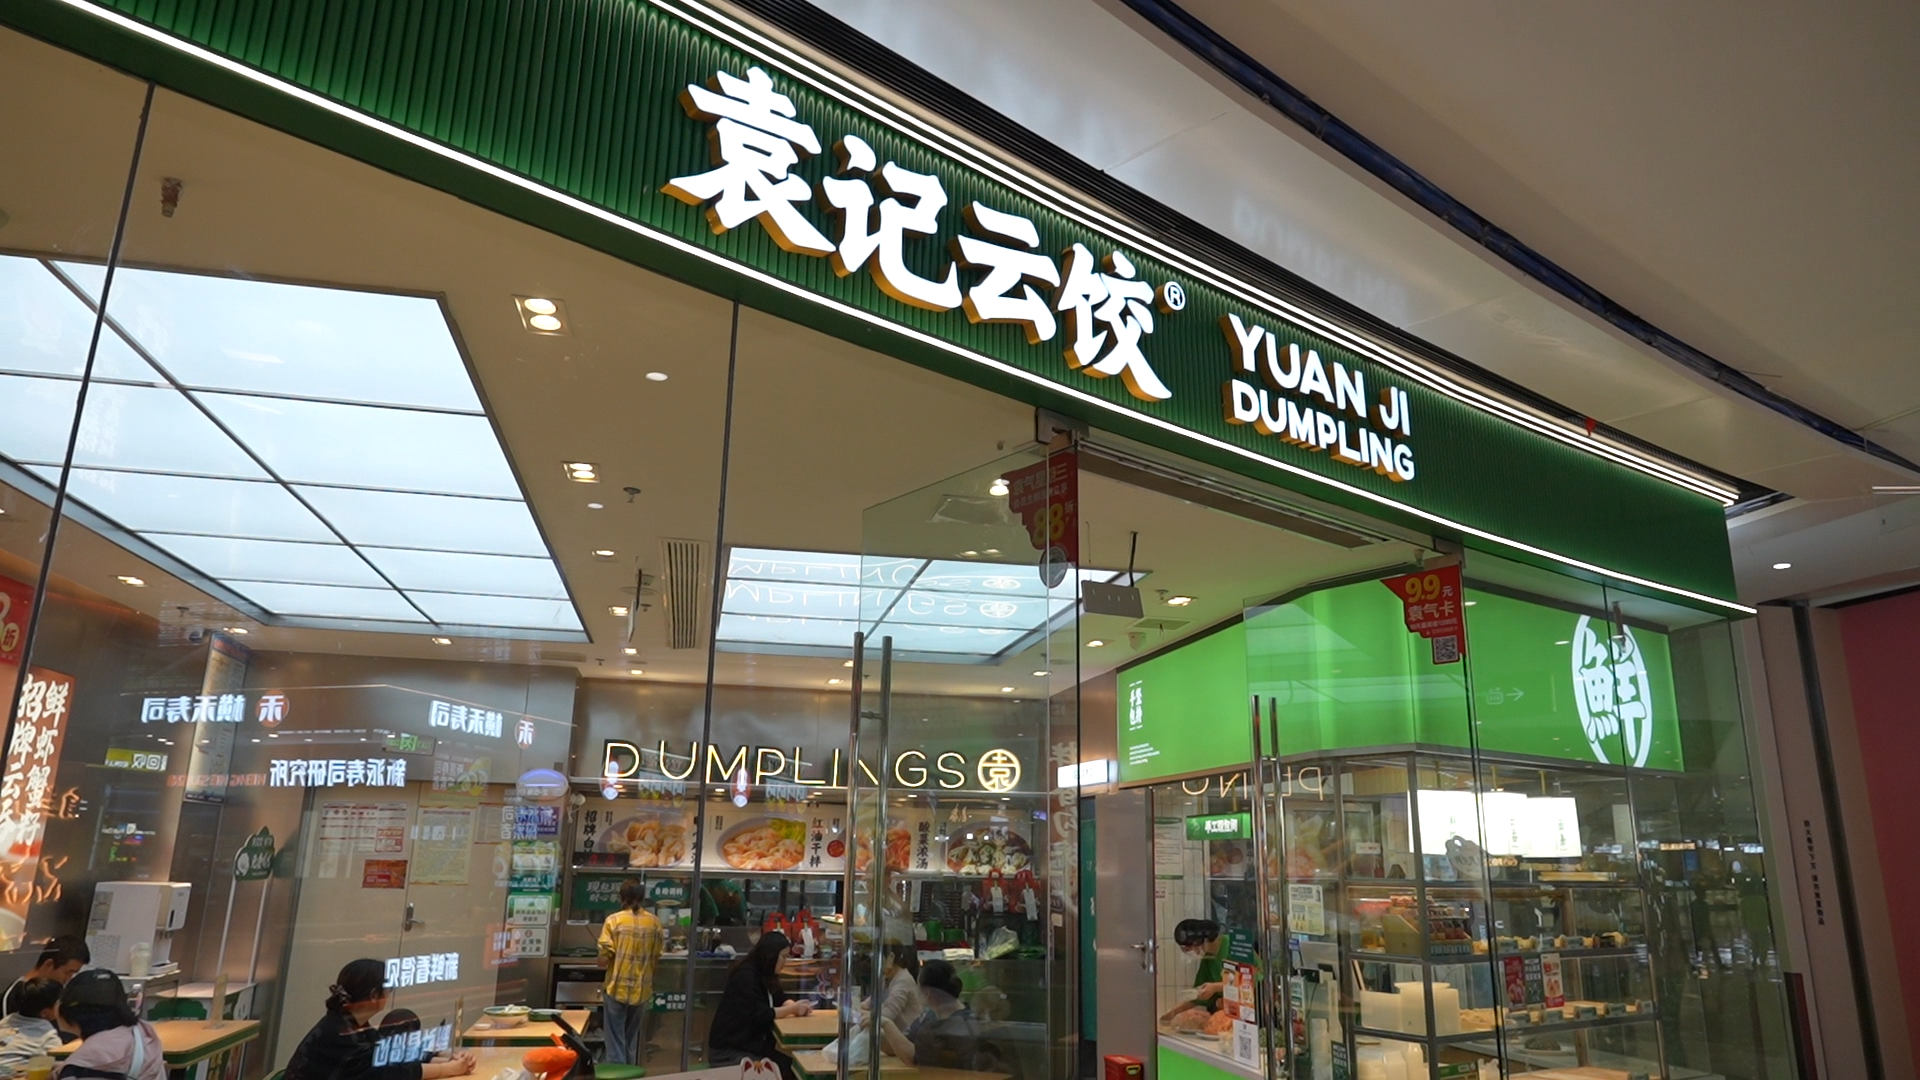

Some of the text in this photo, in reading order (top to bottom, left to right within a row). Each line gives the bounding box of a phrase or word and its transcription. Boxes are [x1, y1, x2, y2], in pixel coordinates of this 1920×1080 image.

[666, 66, 1172, 401] 袁记云饺
[1227, 313, 1411, 437] YUAN JI
[1231, 378, 1415, 481] DUMPLING
[1407, 600, 1455, 621] 袁气卡
[583, 810, 598, 853] 招牌白
[809, 817, 824, 868] 红油干拌
[915, 821, 931, 870] 酸菜浓汤
